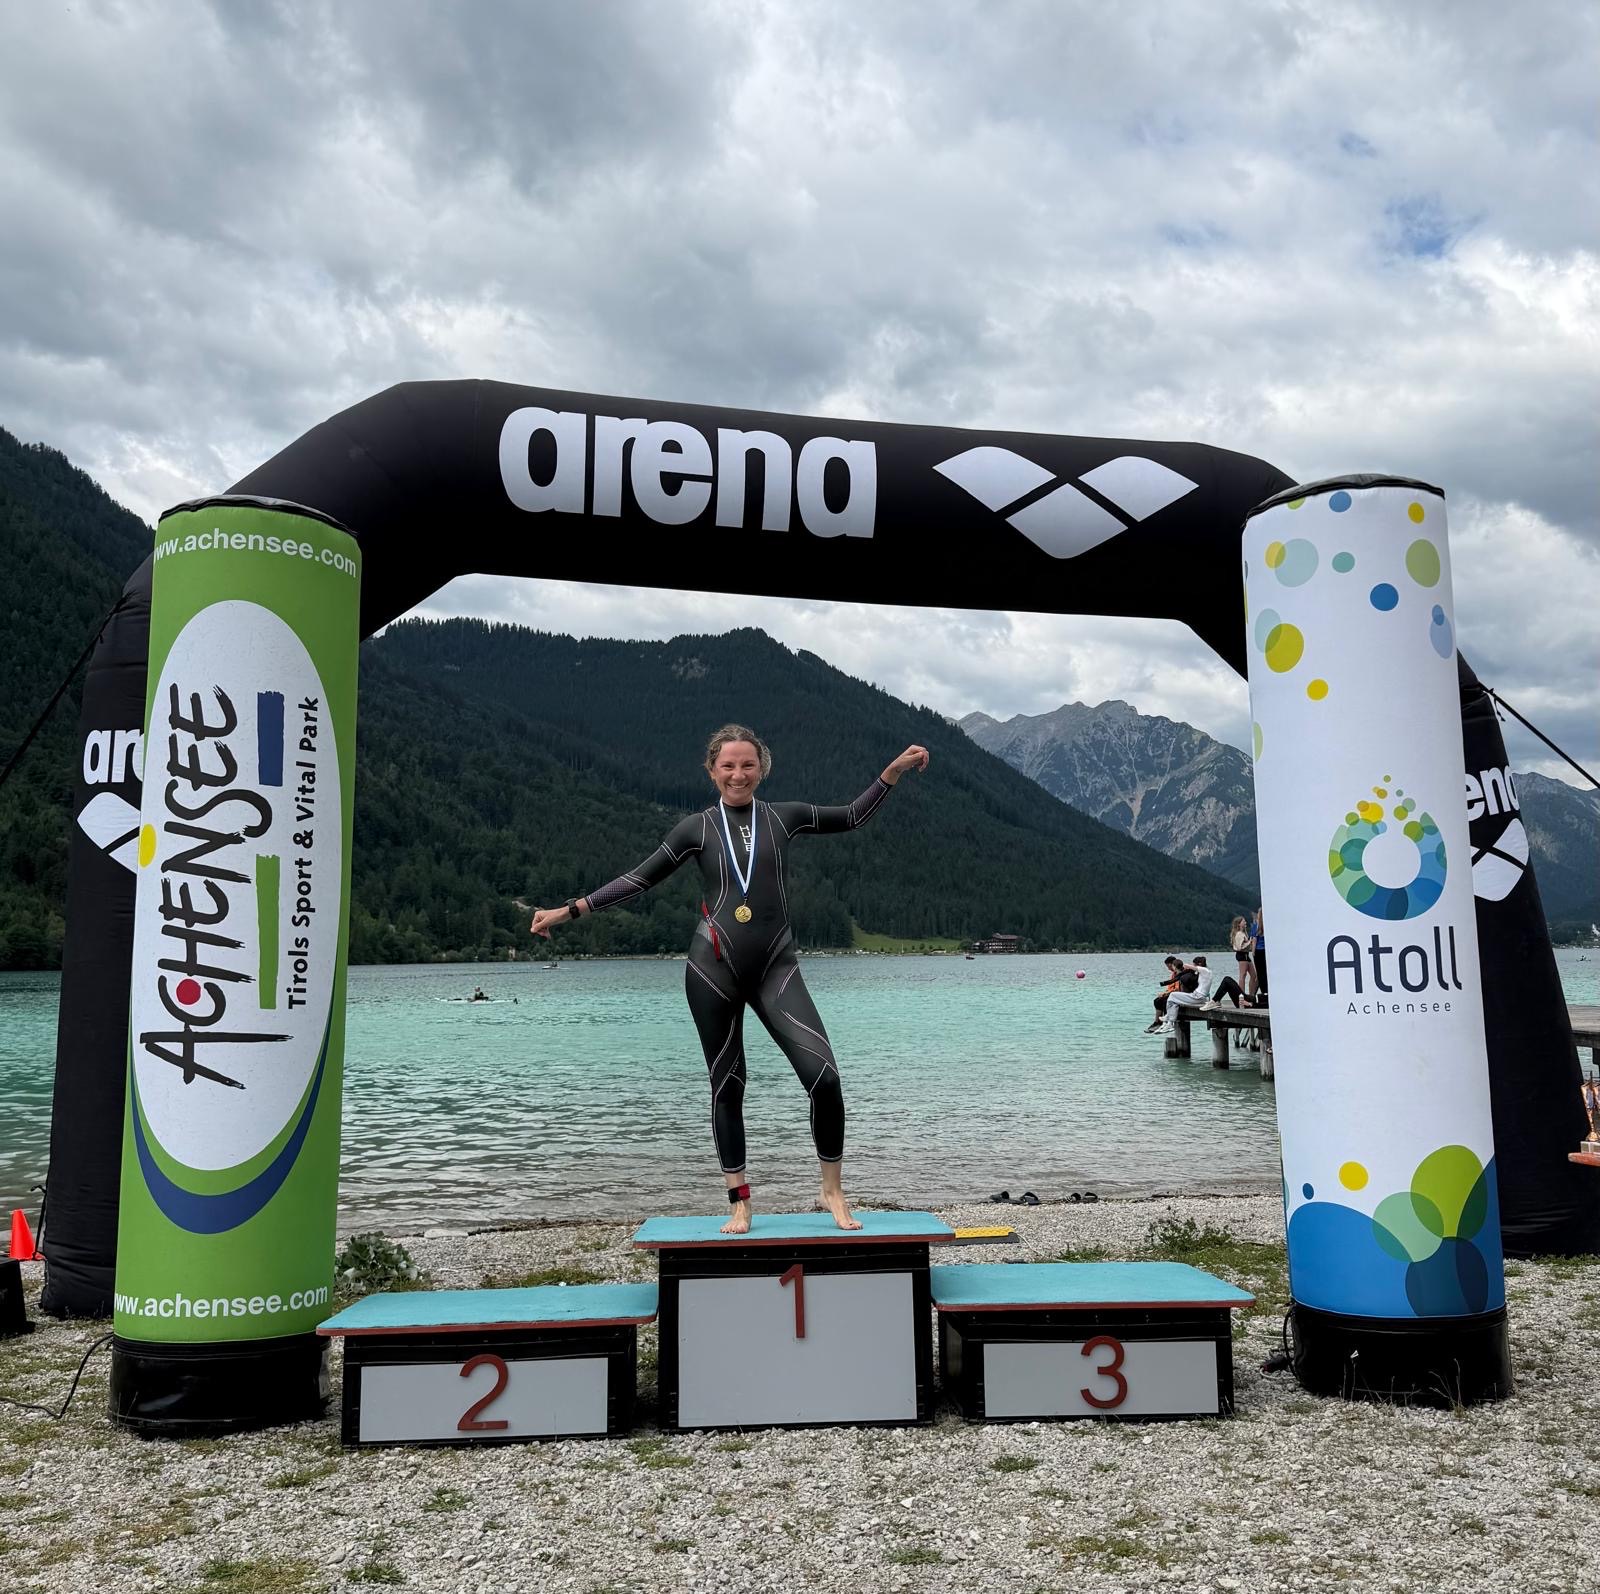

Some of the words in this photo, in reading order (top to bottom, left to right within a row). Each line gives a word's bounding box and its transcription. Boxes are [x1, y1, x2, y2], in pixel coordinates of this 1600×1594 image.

[498, 406, 878, 539] arena
[298, 696, 319, 752] Park
[294, 760, 317, 822] Vital
[292, 829, 314, 849] &
[140, 682, 293, 1089] ACHENSEE
[291, 857, 316, 928] Sport
[286, 936, 309, 1009] Tirols
[1326, 925, 1463, 995] Atoll
[1347, 1000, 1452, 1016] Achensee
[779, 1263, 807, 1339] 1
[456, 1353, 511, 1431] 2
[1080, 1335, 1129, 1409] 3
